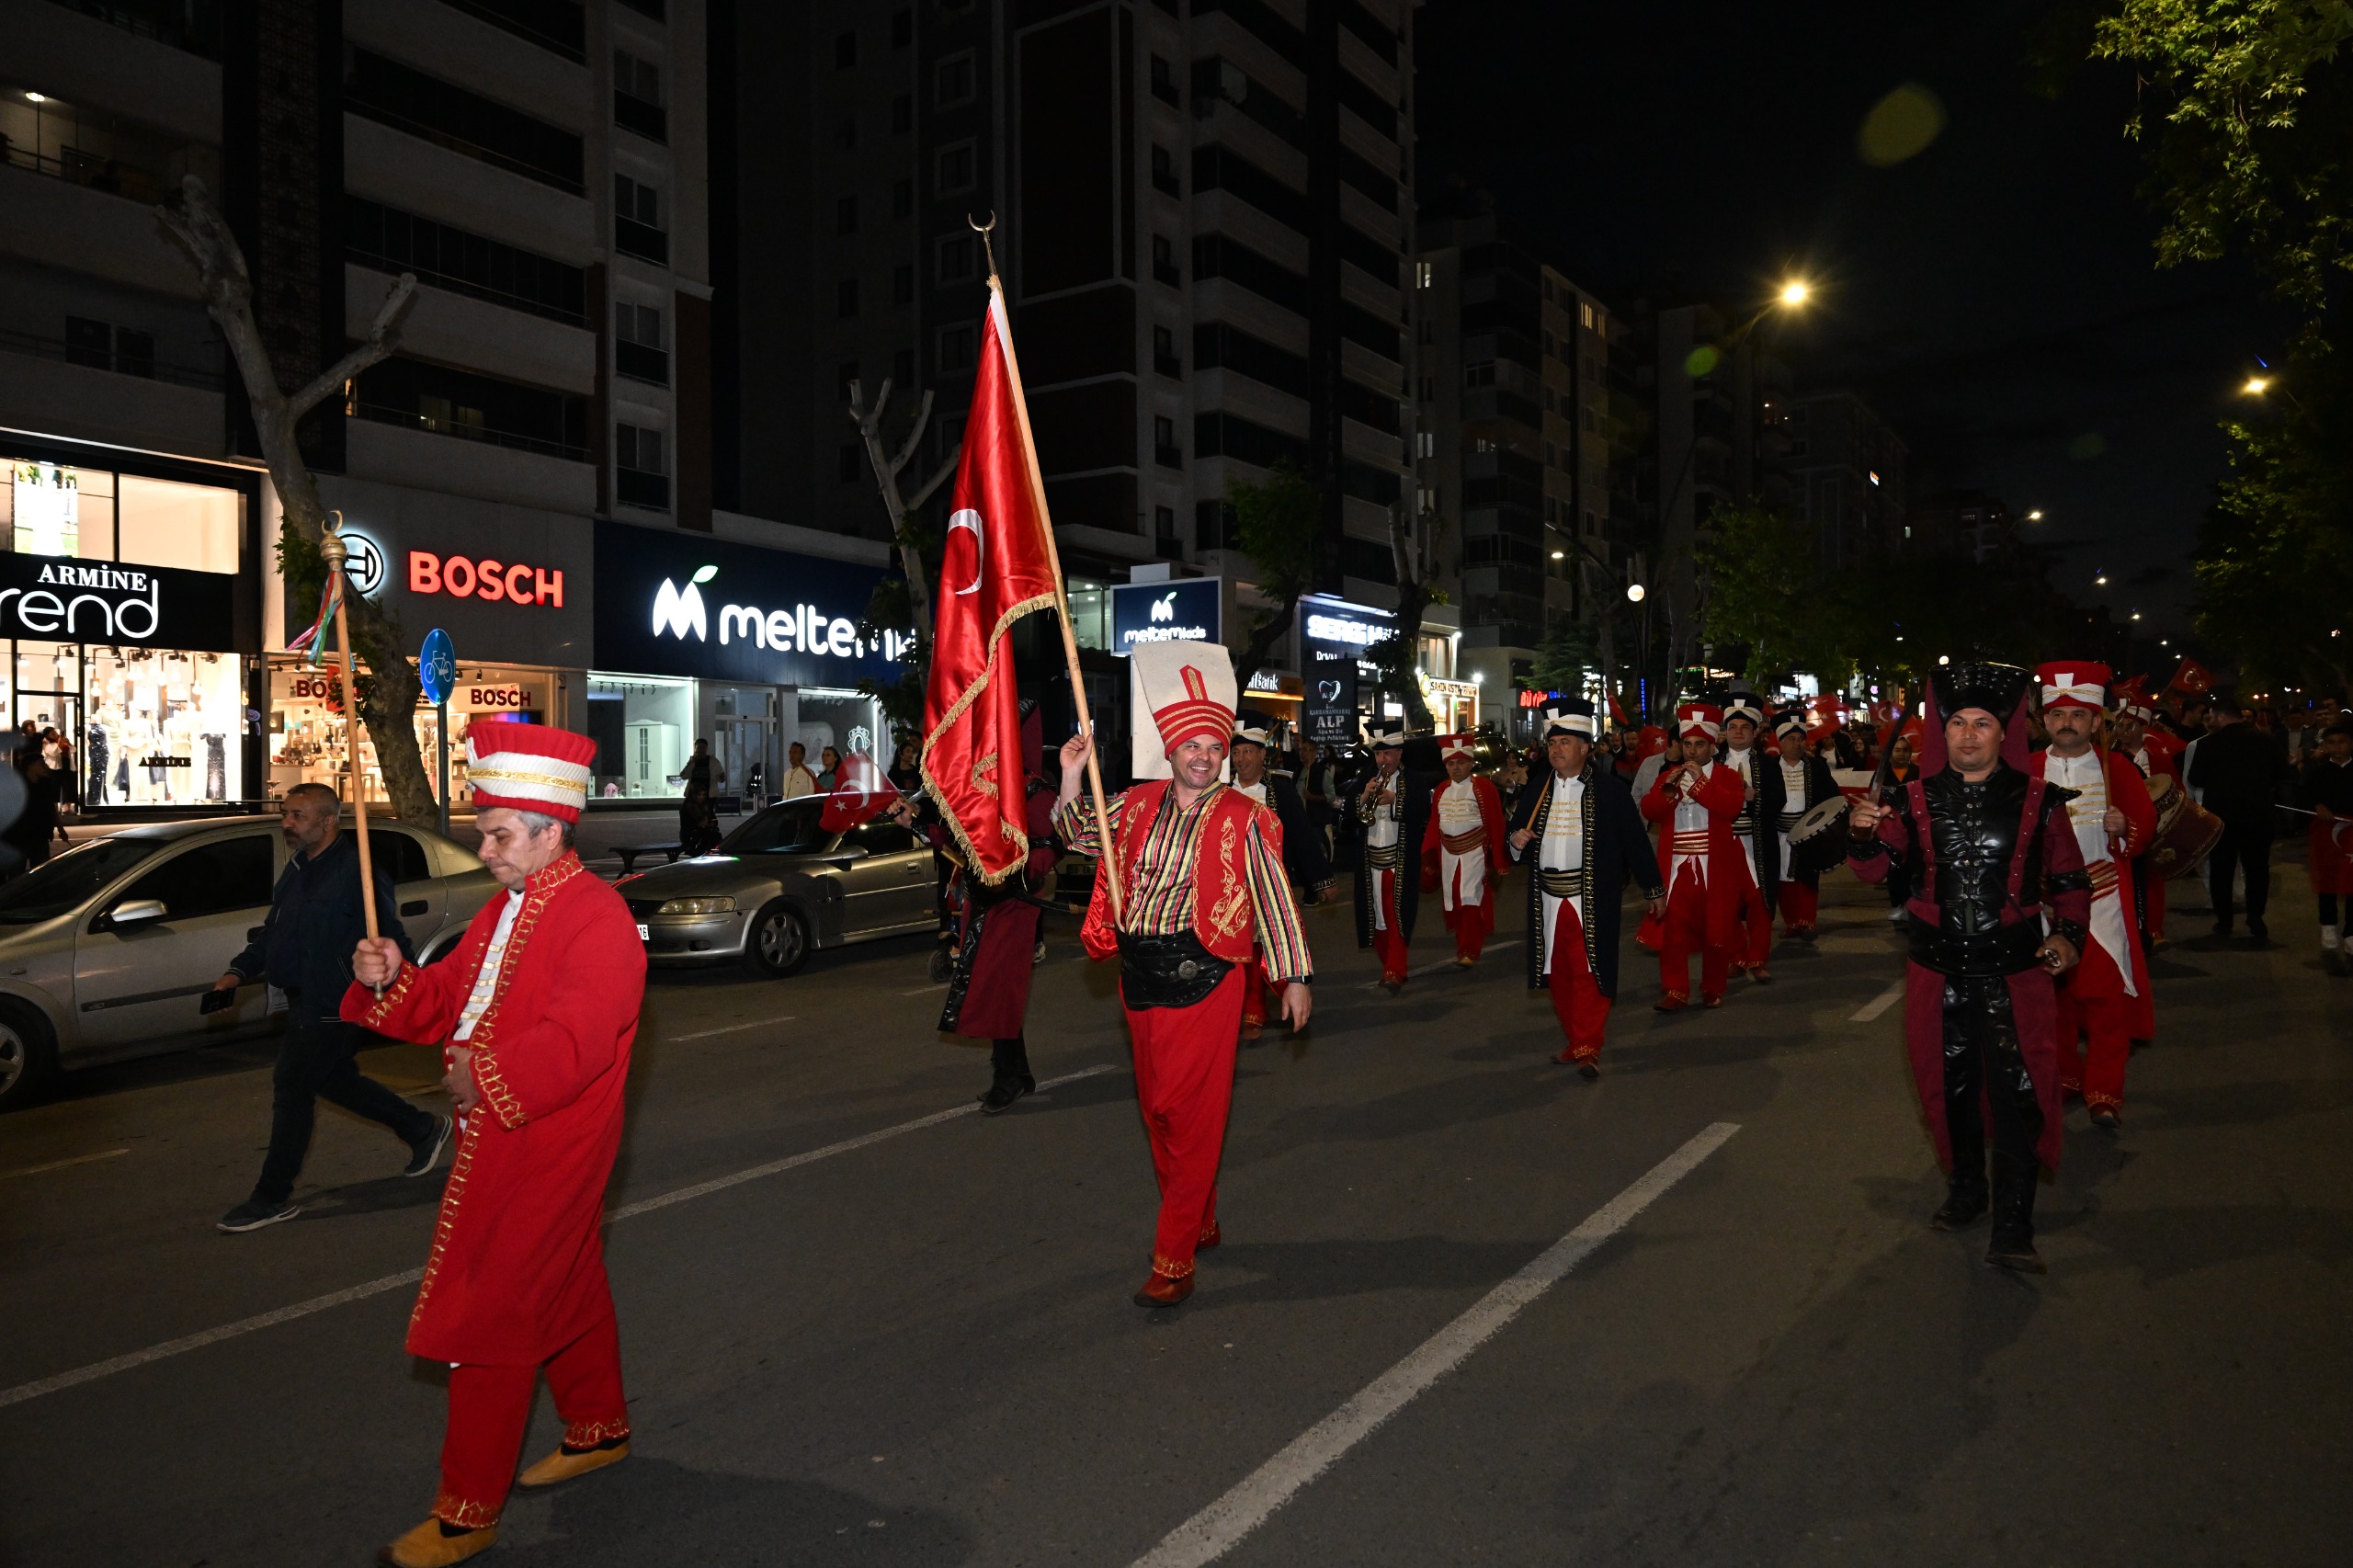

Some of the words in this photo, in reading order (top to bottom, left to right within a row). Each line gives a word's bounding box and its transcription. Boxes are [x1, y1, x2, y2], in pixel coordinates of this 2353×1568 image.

[37, 563, 148, 592] ARMİNE
[410, 551, 563, 608] BOSCH
[471, 688, 531, 707] BOSCH
[1316, 715, 1345, 728] ALP
